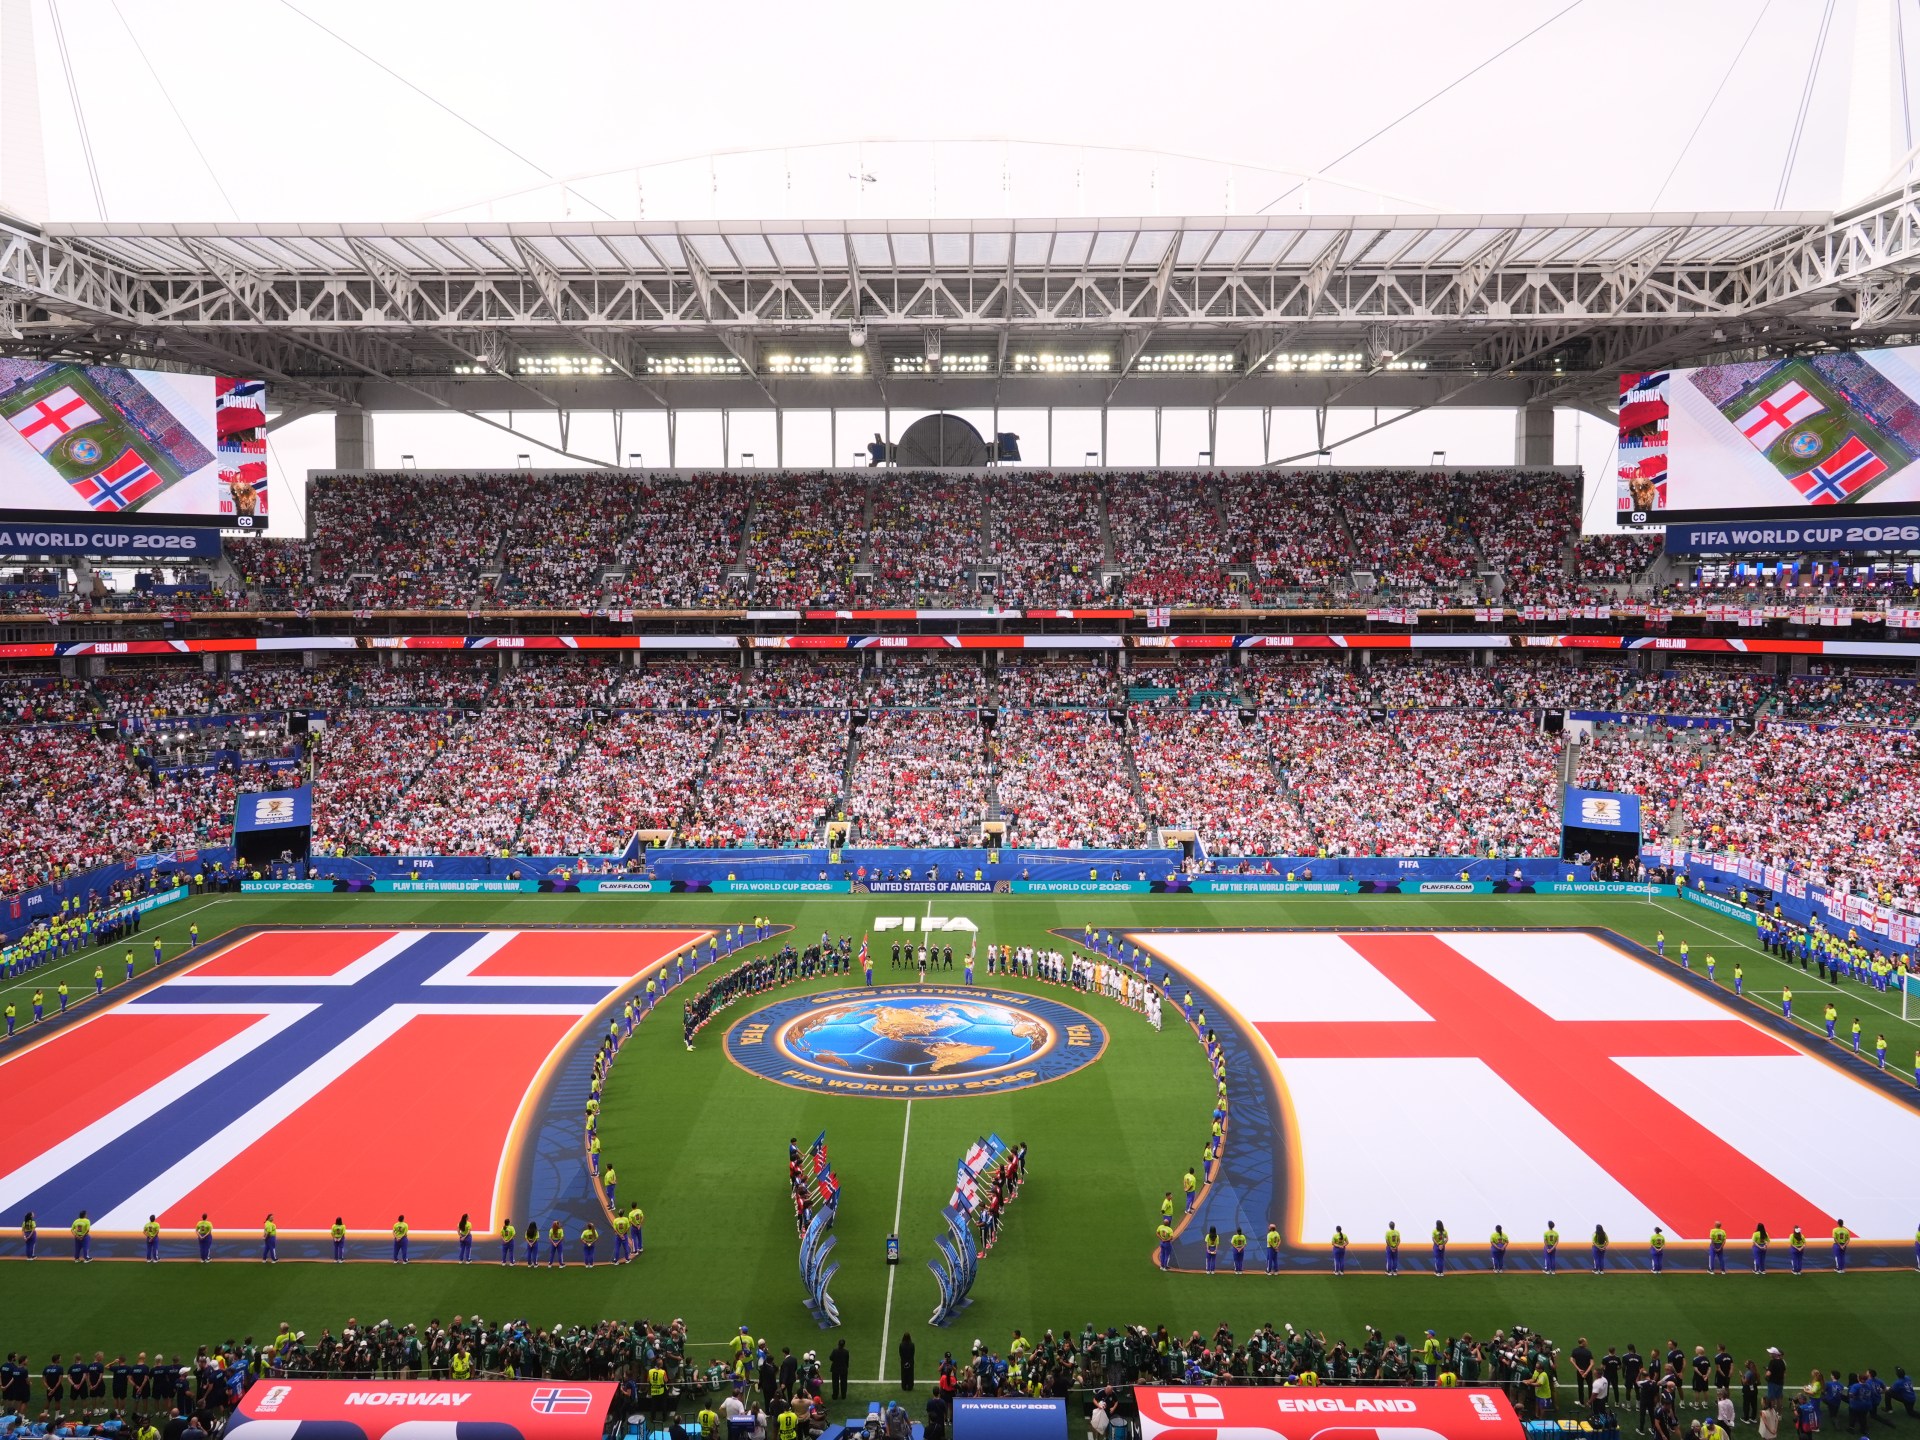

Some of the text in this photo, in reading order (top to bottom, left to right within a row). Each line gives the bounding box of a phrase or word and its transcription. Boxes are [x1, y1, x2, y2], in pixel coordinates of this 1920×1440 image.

[1633, 513, 1645, 521] CC
[15, 532, 89, 547] WORLD
[91, 533, 130, 547] CUP
[133, 534, 197, 549] 2026
[1690, 526, 1920, 545] FIFA WORLD CUP 2026
[372, 637, 399, 647] NORWAY
[496, 637, 525, 647] ENGLAND
[754, 637, 782, 647] NORWAY
[879, 637, 908, 647] ENGLAND
[1139, 637, 1167, 646] NORWAY
[1265, 636, 1294, 646] ENGLAND
[1527, 636, 1554, 646] NORWAY
[1656, 638, 1687, 648] ENGLAND
[94, 643, 128, 653] ENGLAND
[413, 859, 434, 868] FIFA
[263, 883, 281, 891] CUP
[282, 883, 313, 891] 2026
[393, 882, 411, 890] PLAY
[411, 882, 425, 890] THE
[425, 882, 440, 890] FIFA
[440, 882, 465, 890] WORLD
[484, 882, 503, 890] YOUR
[503, 882, 520, 890] WAY
[870, 882, 991, 891] UNITED STATES OF AMERICA
[1211, 883, 1229, 891] PLAY
[1230, 883, 1244, 891] THE
[1243, 883, 1258, 891] FIFA
[1259, 883, 1284, 891] WORLD
[1303, 883, 1323, 891] YOUR
[1323, 883, 1340, 891] WAY
[1607, 884, 1625, 892] CUP
[1626, 885, 1660, 894] 2026
[27, 894, 43, 907] FIFA
[1688, 891, 1752, 921] FIFA WORLD CUP 2026
[873, 916, 979, 932] FIFA
[920, 988, 988, 998] WORLD
[740, 1023, 769, 1046] FIFA
[1067, 1023, 1091, 1047] FIFA
[782, 1069, 1039, 1092] FIFA WORLD CUP 2026
[344, 1392, 473, 1406] NORWAY
[1277, 1398, 1417, 1413] ENGLAND
